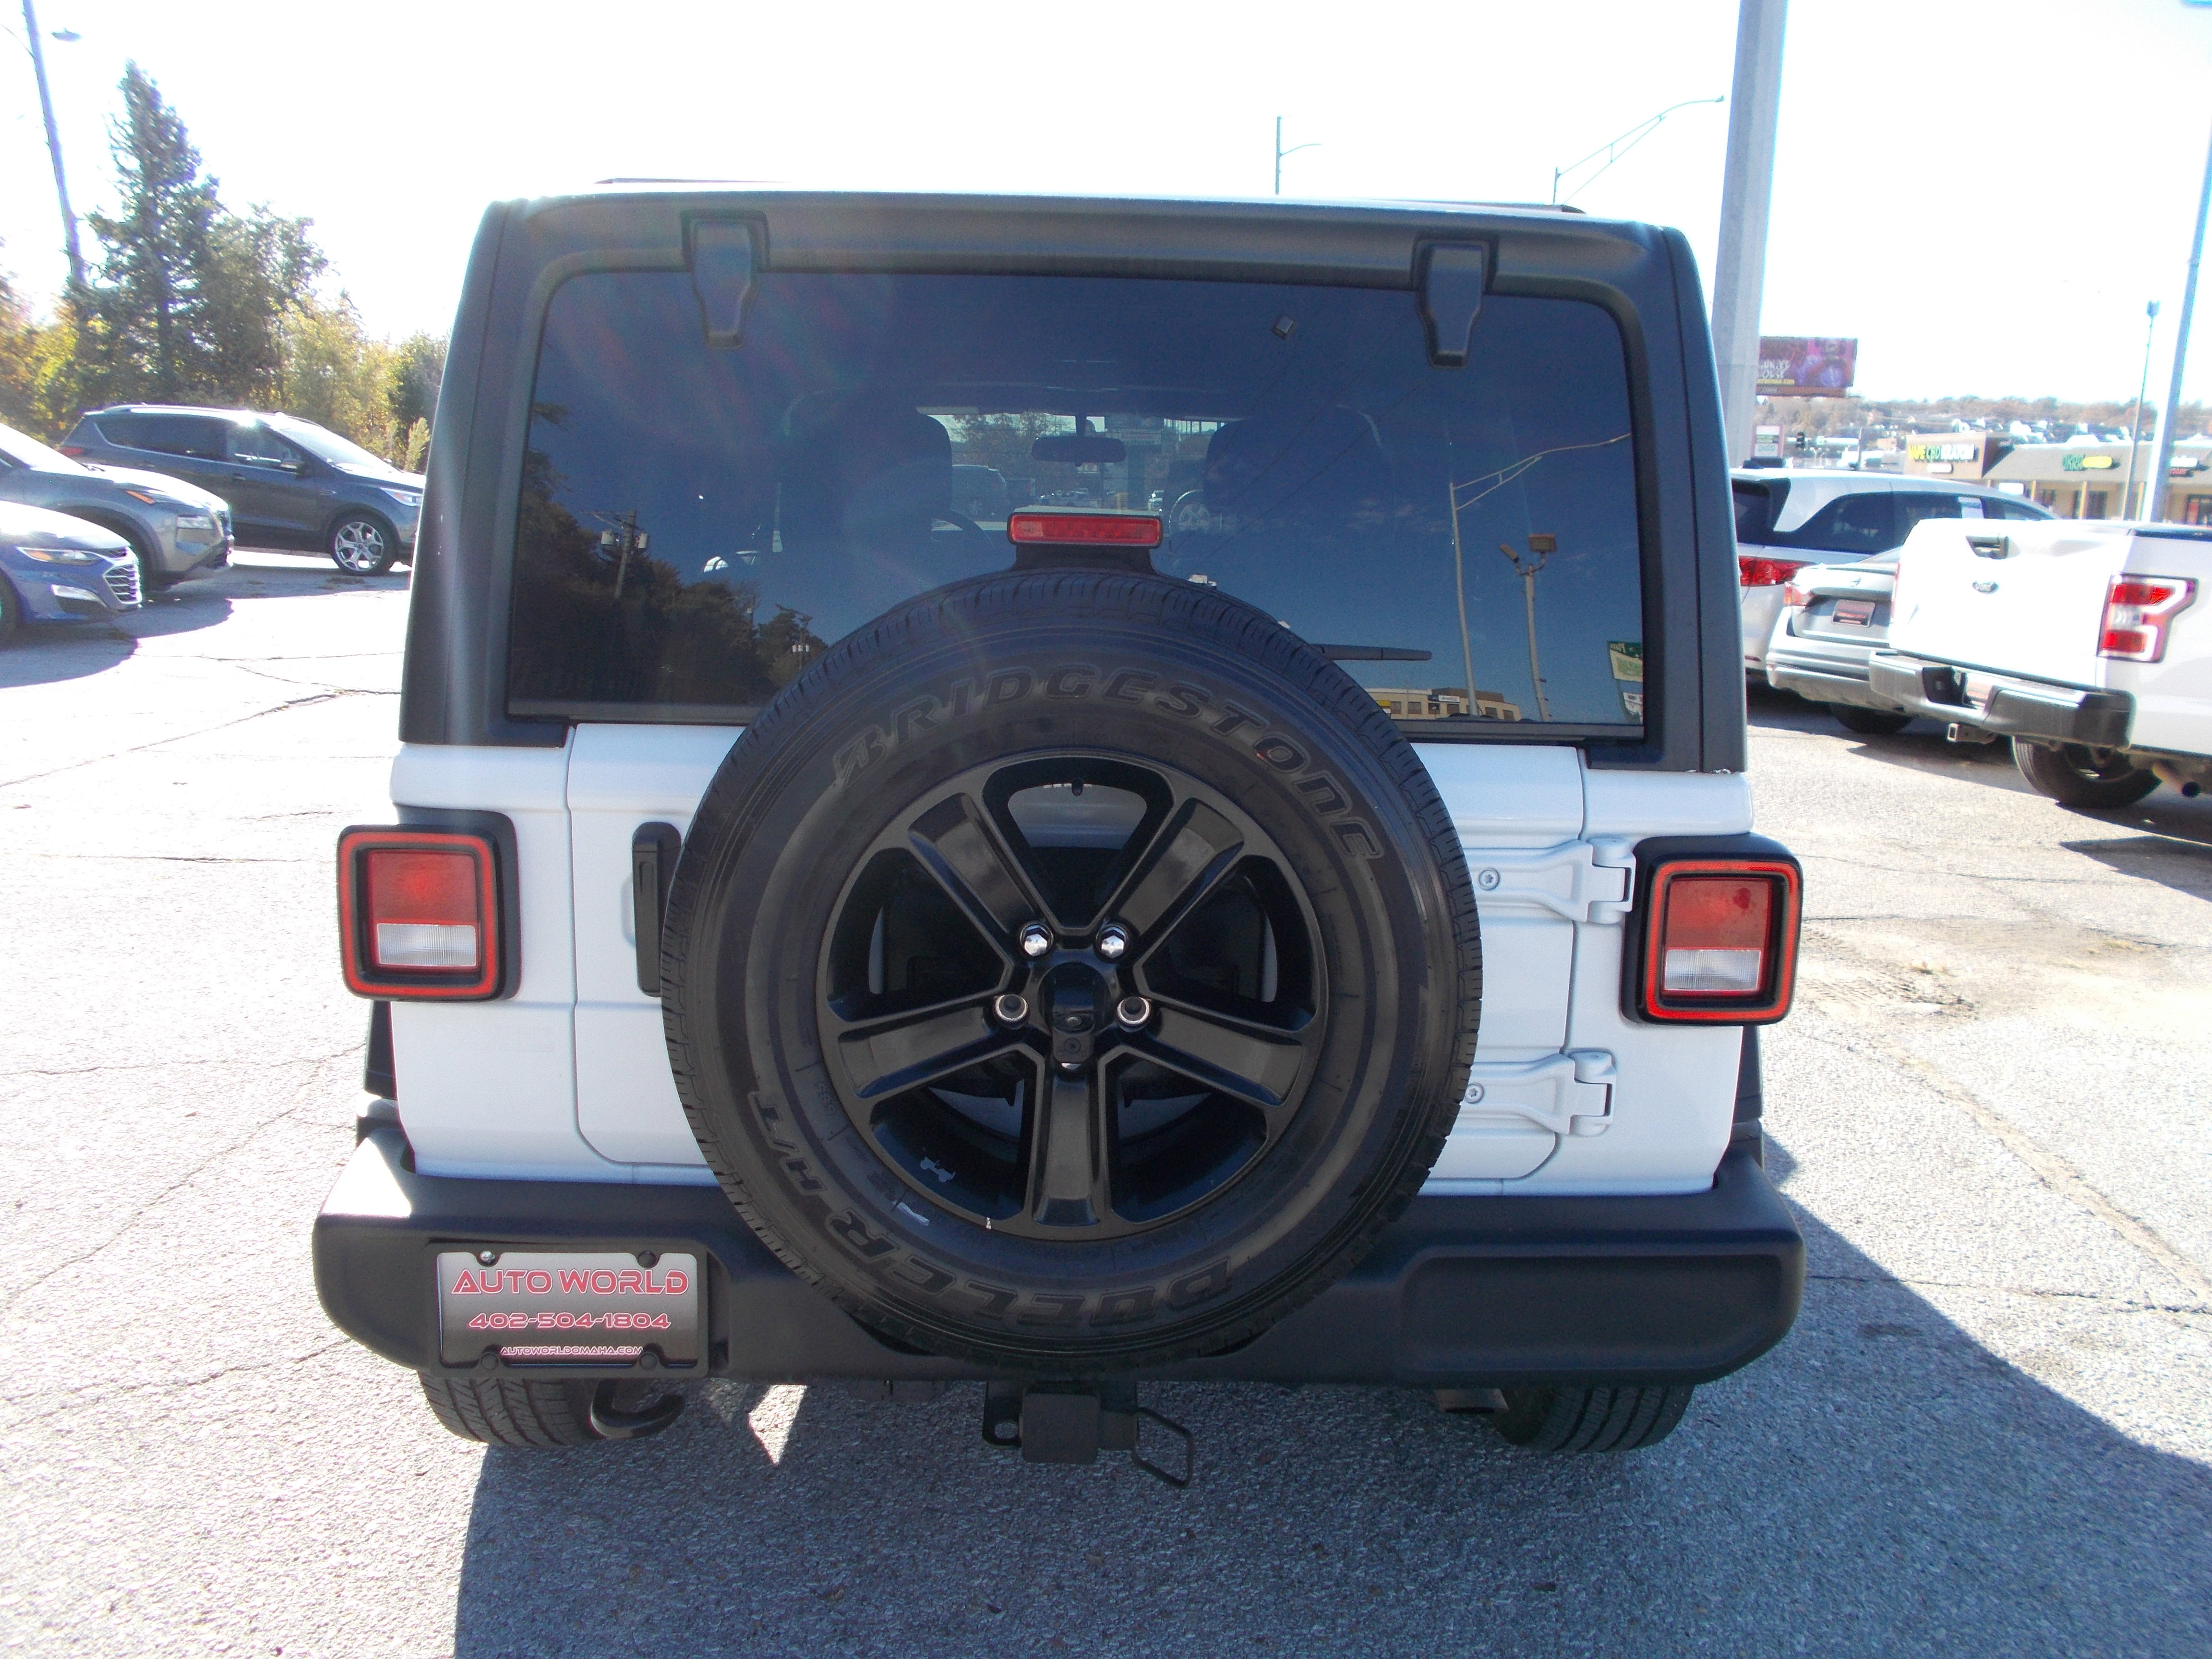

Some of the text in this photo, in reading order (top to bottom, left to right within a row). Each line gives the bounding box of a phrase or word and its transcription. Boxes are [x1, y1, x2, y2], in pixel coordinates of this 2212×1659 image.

[1908, 445, 1926, 459] VAPE
[1926, 445, 1940, 459] CBD
[833, 662, 1385, 860] BRIDGESTONE
[825, 1207, 1231, 1327] DUELER
[451, 1269, 689, 1295] AUTO WORLD
[469, 1312, 672, 1329] 402-504-1804
[500, 1346, 643, 1356] AUTOWORLDOMAHA.COM
